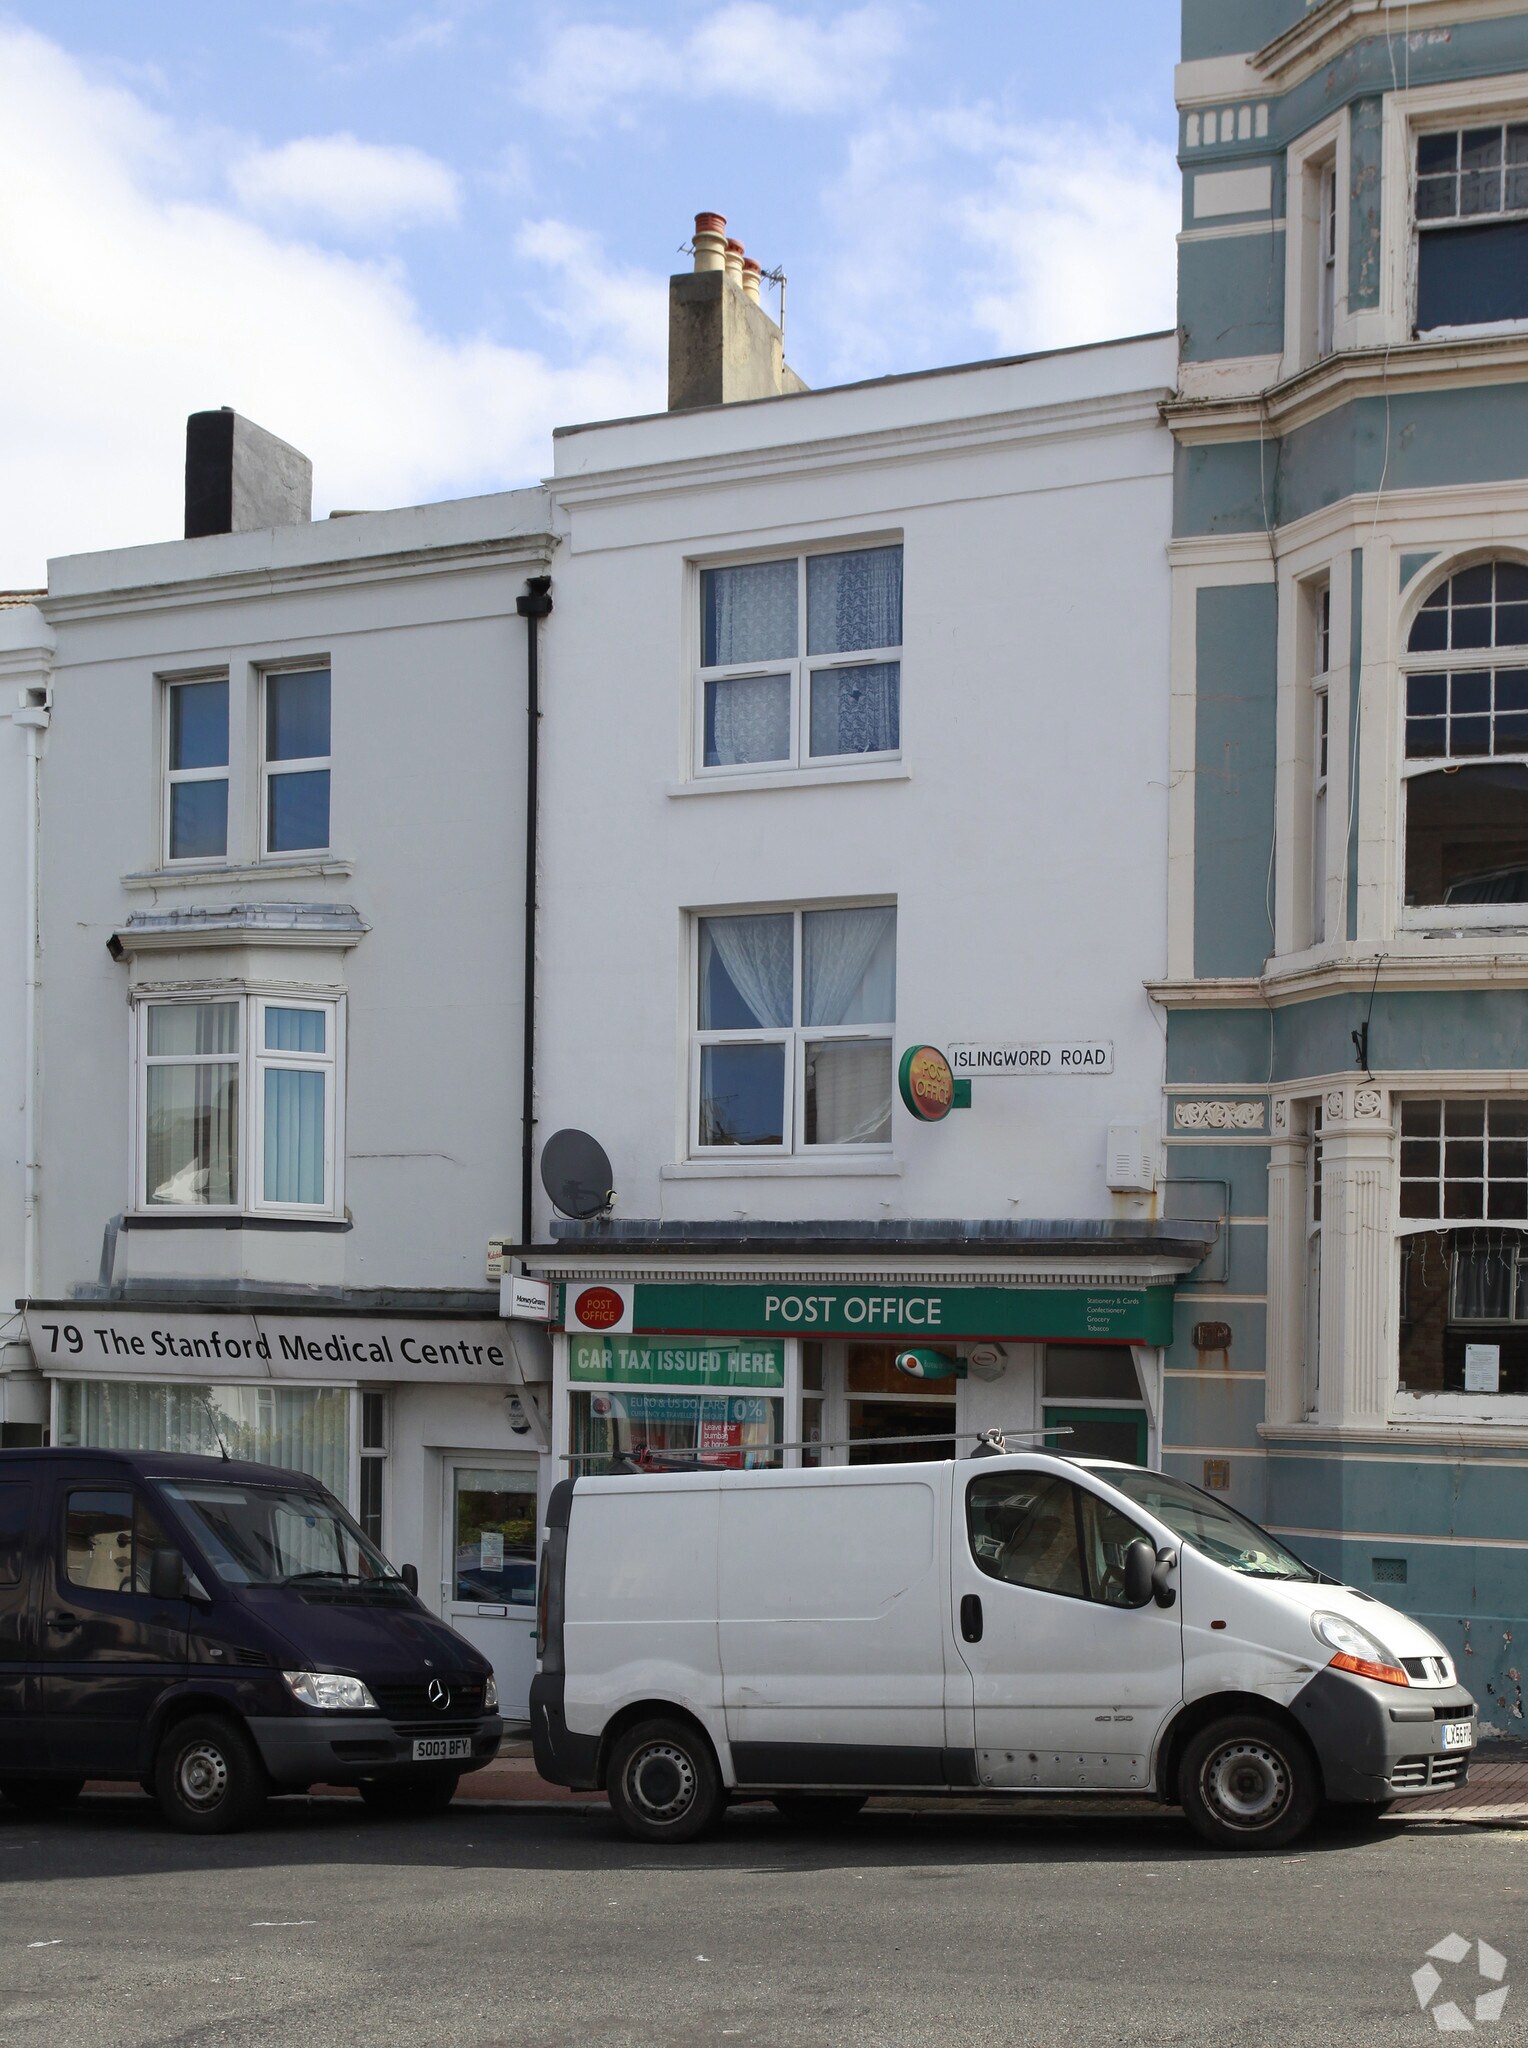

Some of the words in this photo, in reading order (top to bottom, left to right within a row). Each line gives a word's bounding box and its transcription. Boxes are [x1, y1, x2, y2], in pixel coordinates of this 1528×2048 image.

[954, 1051, 1051, 1067] ISLINGWORD
[1061, 1049, 1106, 1066] ROAD
[921, 1060, 947, 1084] POST
[915, 1080, 950, 1106] OFFICE
[516, 1294, 546, 1306] MoneyGram
[587, 1299, 612, 1310] POST
[1086, 1297, 1115, 1306] Stationery
[1116, 1297, 1121, 1305] &
[1122, 1297, 1140, 1305] Cards
[765, 1295, 837, 1322] POST
[843, 1297, 942, 1324] OFFICE
[1086, 1306, 1127, 1315] Confectionery
[582, 1311, 615, 1322] OFFICE
[1086, 1315, 1110, 1324] Grocery
[41, 1325, 84, 1353] 79
[93, 1328, 146, 1355] The
[151, 1330, 272, 1360] Stanford
[278, 1334, 394, 1363] Medical
[400, 1337, 505, 1366] Centre
[577, 1348, 613, 1369] CAR
[618, 1349, 652, 1370] TAX
[657, 1350, 721, 1372] ISSUED
[727, 1352, 776, 1374] HERE
[630, 1397, 658, 1408] EURO
[659, 1397, 667, 1409] &
[667, 1397, 681, 1409] US
[682, 1398, 727, 1411] DOLLARS
[733, 1398, 763, 1421] 0%
[703, 1423, 722, 1432] Leave
[722, 1424, 736, 1435] your
[703, 1431, 729, 1442] bumbag
[703, 1440, 711, 1448] at
[712, 1440, 729, 1449] home
[449, 1739, 468, 1755] BFY
